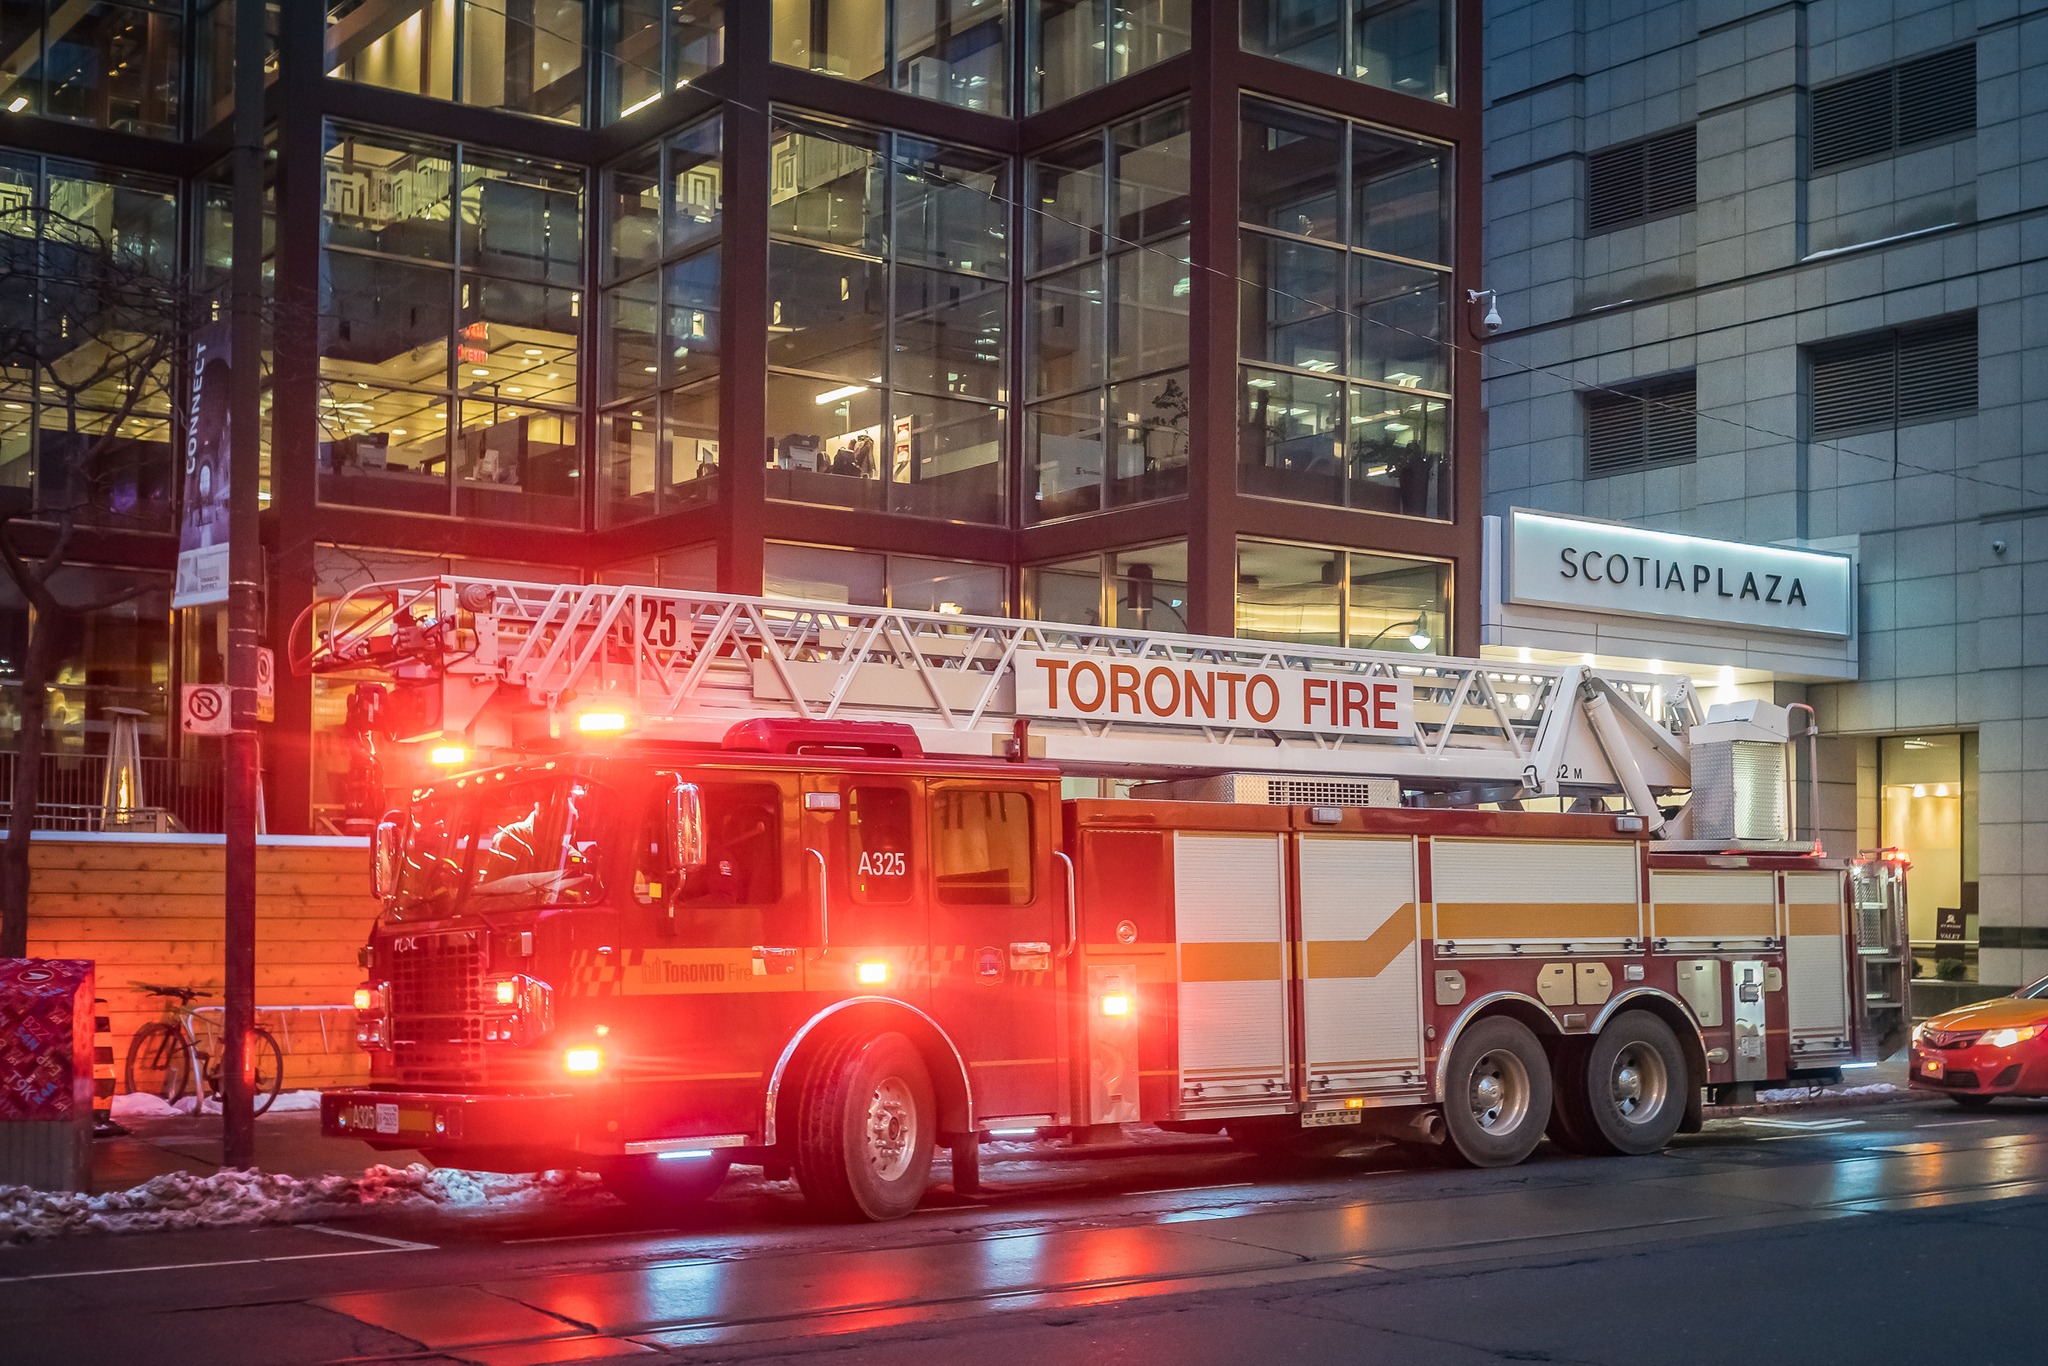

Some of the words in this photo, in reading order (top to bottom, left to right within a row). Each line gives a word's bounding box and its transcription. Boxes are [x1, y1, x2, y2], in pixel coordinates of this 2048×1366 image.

[186, 343, 206, 475] CONNECT
[1036, 658, 1281, 723] TORONTO
[1303, 678, 1399, 730] FIRE
[1574, 768, 1582, 779] M
[857, 851, 906, 876] A325
[663, 960, 725, 983] TORONTO
[728, 962, 753, 982] Fire
[8, 1069, 38, 1102] T9K
[353, 1104, 375, 1130] A325
